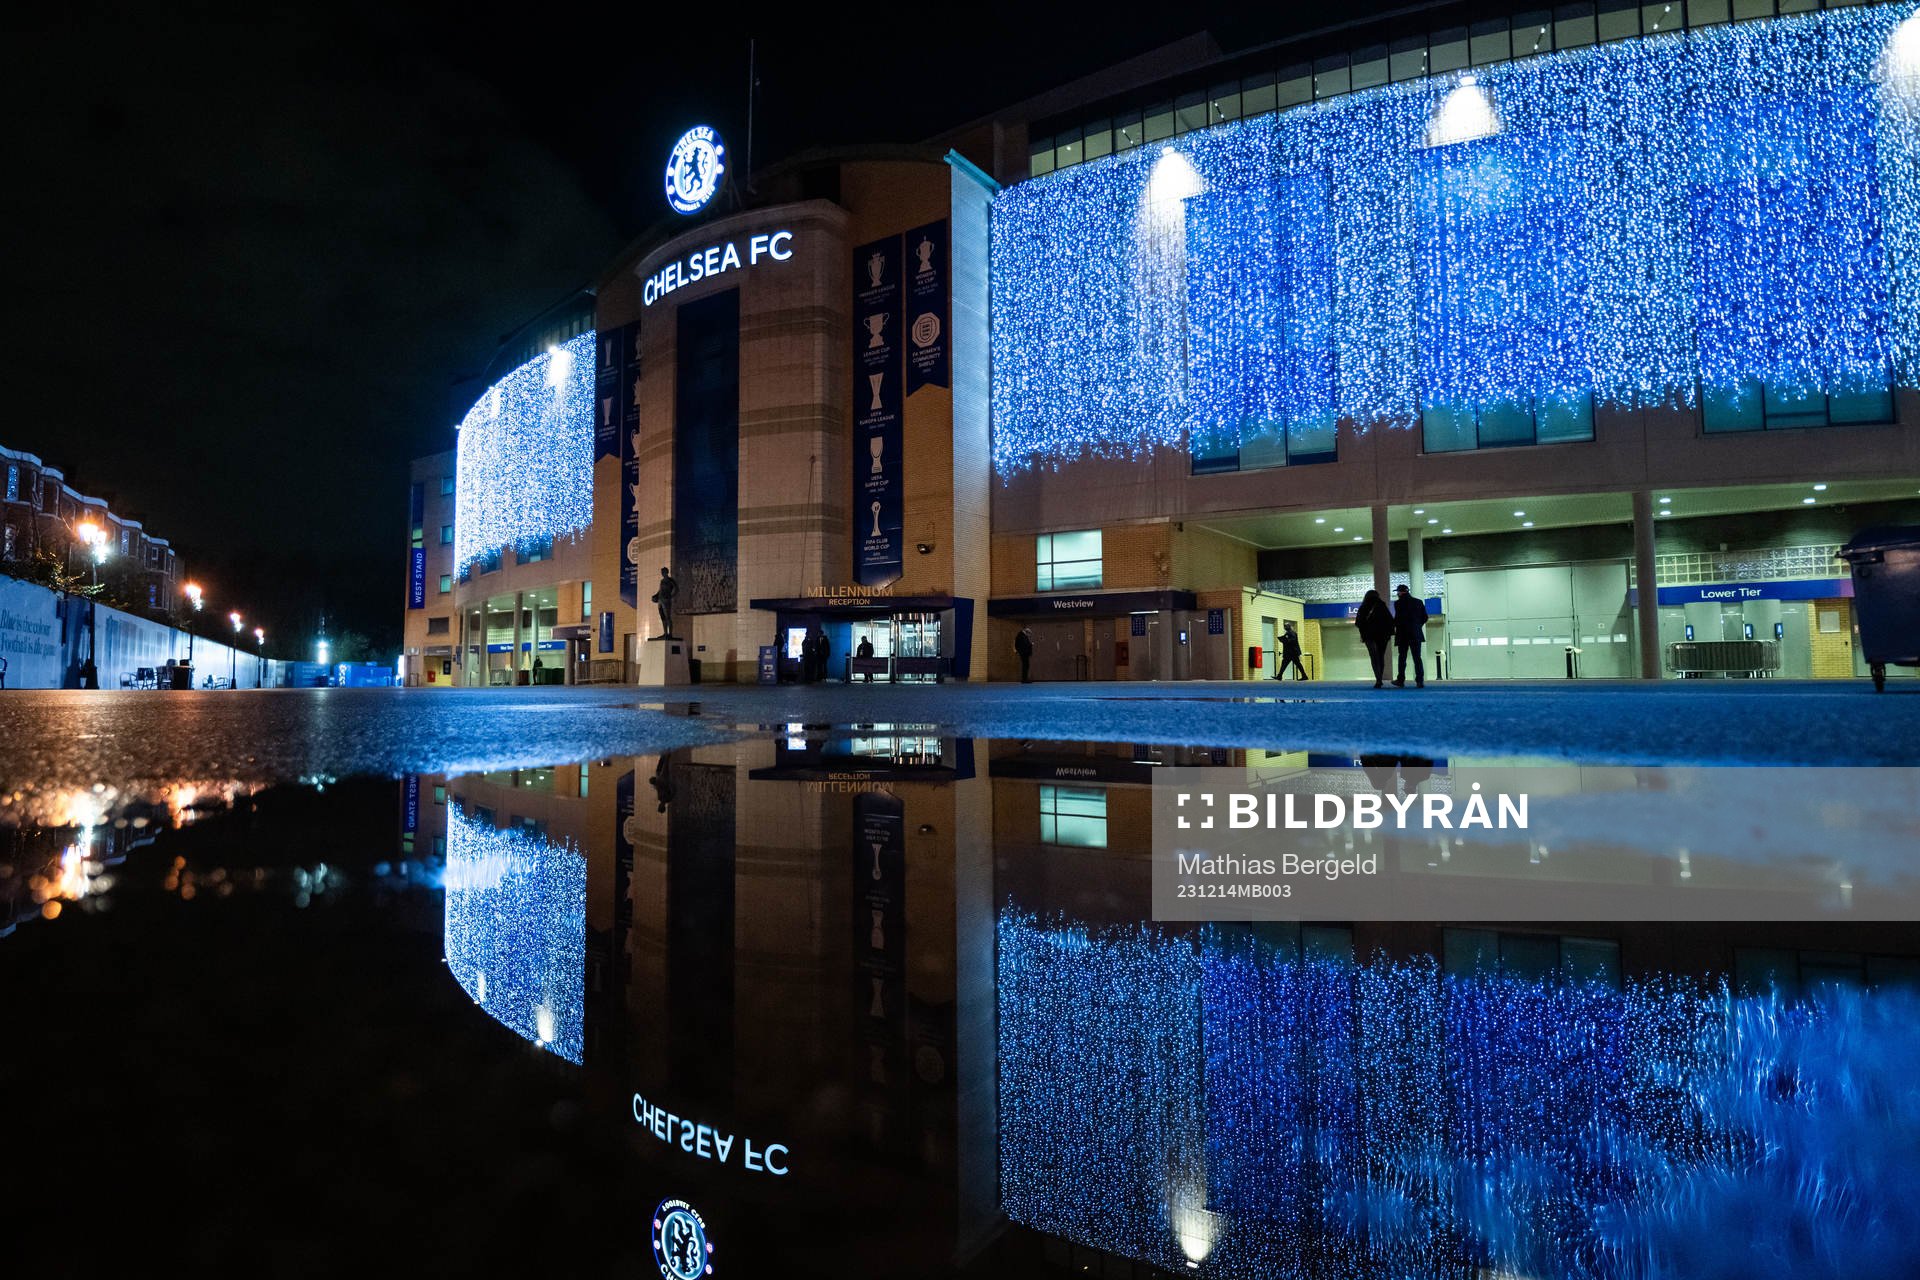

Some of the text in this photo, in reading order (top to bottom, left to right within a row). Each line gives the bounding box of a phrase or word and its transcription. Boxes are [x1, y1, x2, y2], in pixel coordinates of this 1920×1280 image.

[674, 127, 714, 156] CHELSEA
[643, 231, 793, 307] CHELSEA FC
[415, 552, 423, 579] STAND
[807, 585, 894, 598] MILLENNIUM
[1701, 587, 1762, 599] Lower Tier
[828, 598, 871, 606] RECEPTION
[1053, 599, 1094, 609] Westview
